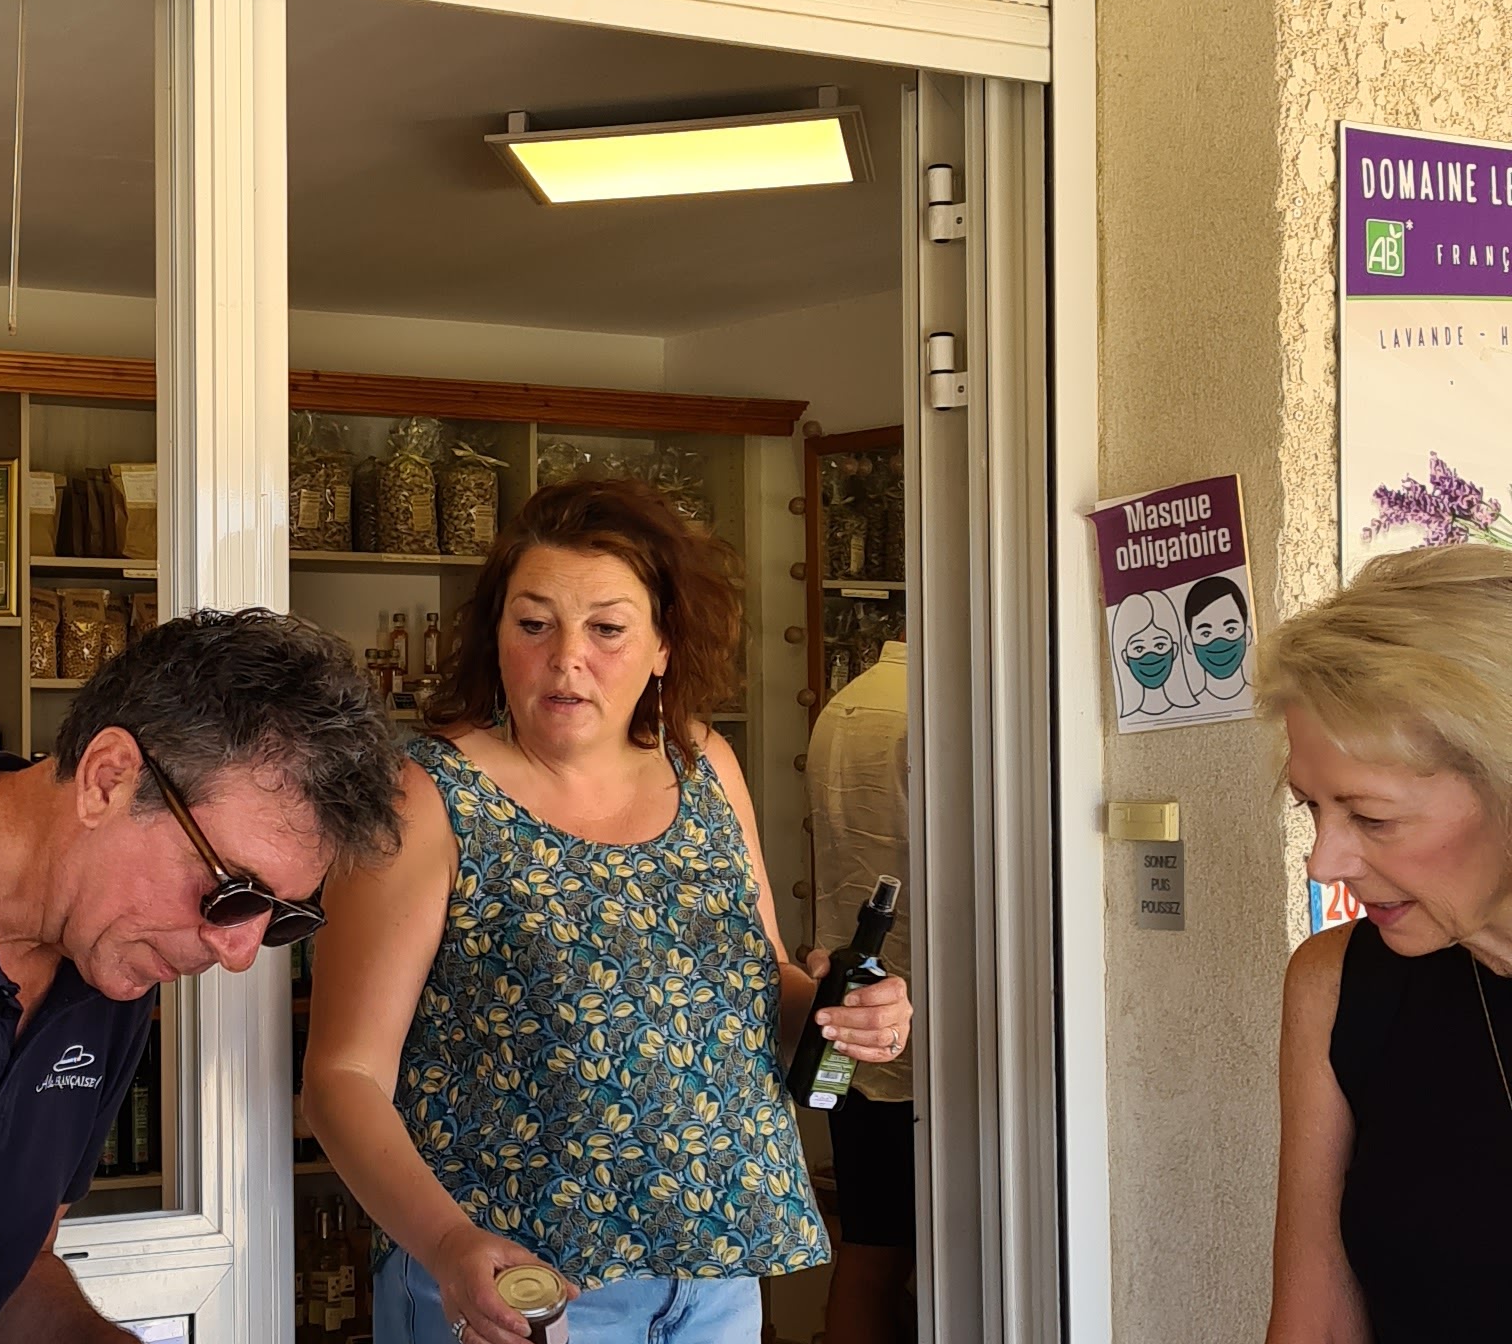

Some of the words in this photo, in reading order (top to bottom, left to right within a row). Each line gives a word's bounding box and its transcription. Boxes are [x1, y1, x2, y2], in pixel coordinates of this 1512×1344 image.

[1361, 158, 1477, 204] DOMAINE
[1369, 236, 1400, 271] AB
[1380, 326, 1463, 349] LAVANDE
[1123, 494, 1212, 533] Masque
[1116, 526, 1231, 571] obligatoire
[1144, 855, 1177, 868] SONNEZ
[1151, 878, 1170, 891] PUIS
[1141, 900, 1180, 915] POUSSEZ
